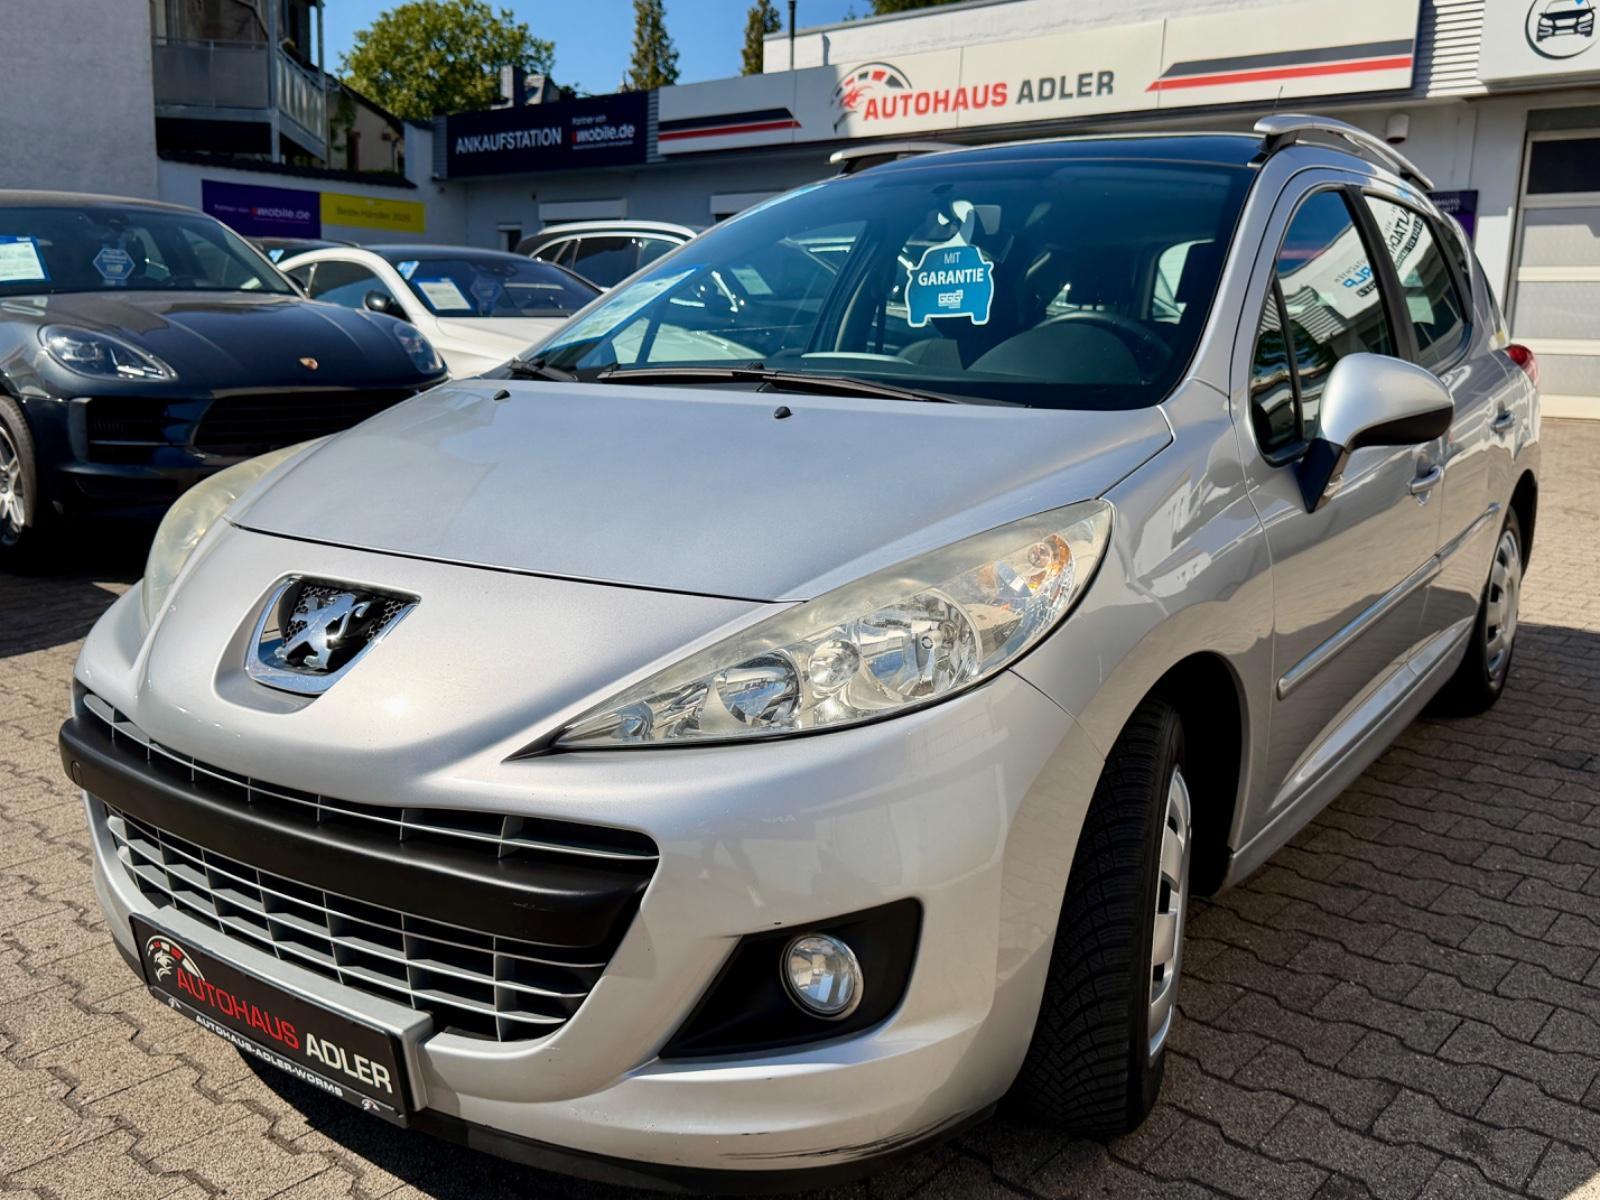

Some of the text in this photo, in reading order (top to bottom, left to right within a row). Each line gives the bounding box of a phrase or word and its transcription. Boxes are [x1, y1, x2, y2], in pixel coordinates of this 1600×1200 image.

[864, 70, 1115, 121] AUTOHAUS ADLER
[455, 127, 562, 154] ANKAUFSTATION
[574, 123, 636, 143] mobile.de
[943, 251, 961, 265] MIT
[917, 267, 985, 287] GARANTIE
[176, 966, 393, 1094] AUTOHAUS ADLER
